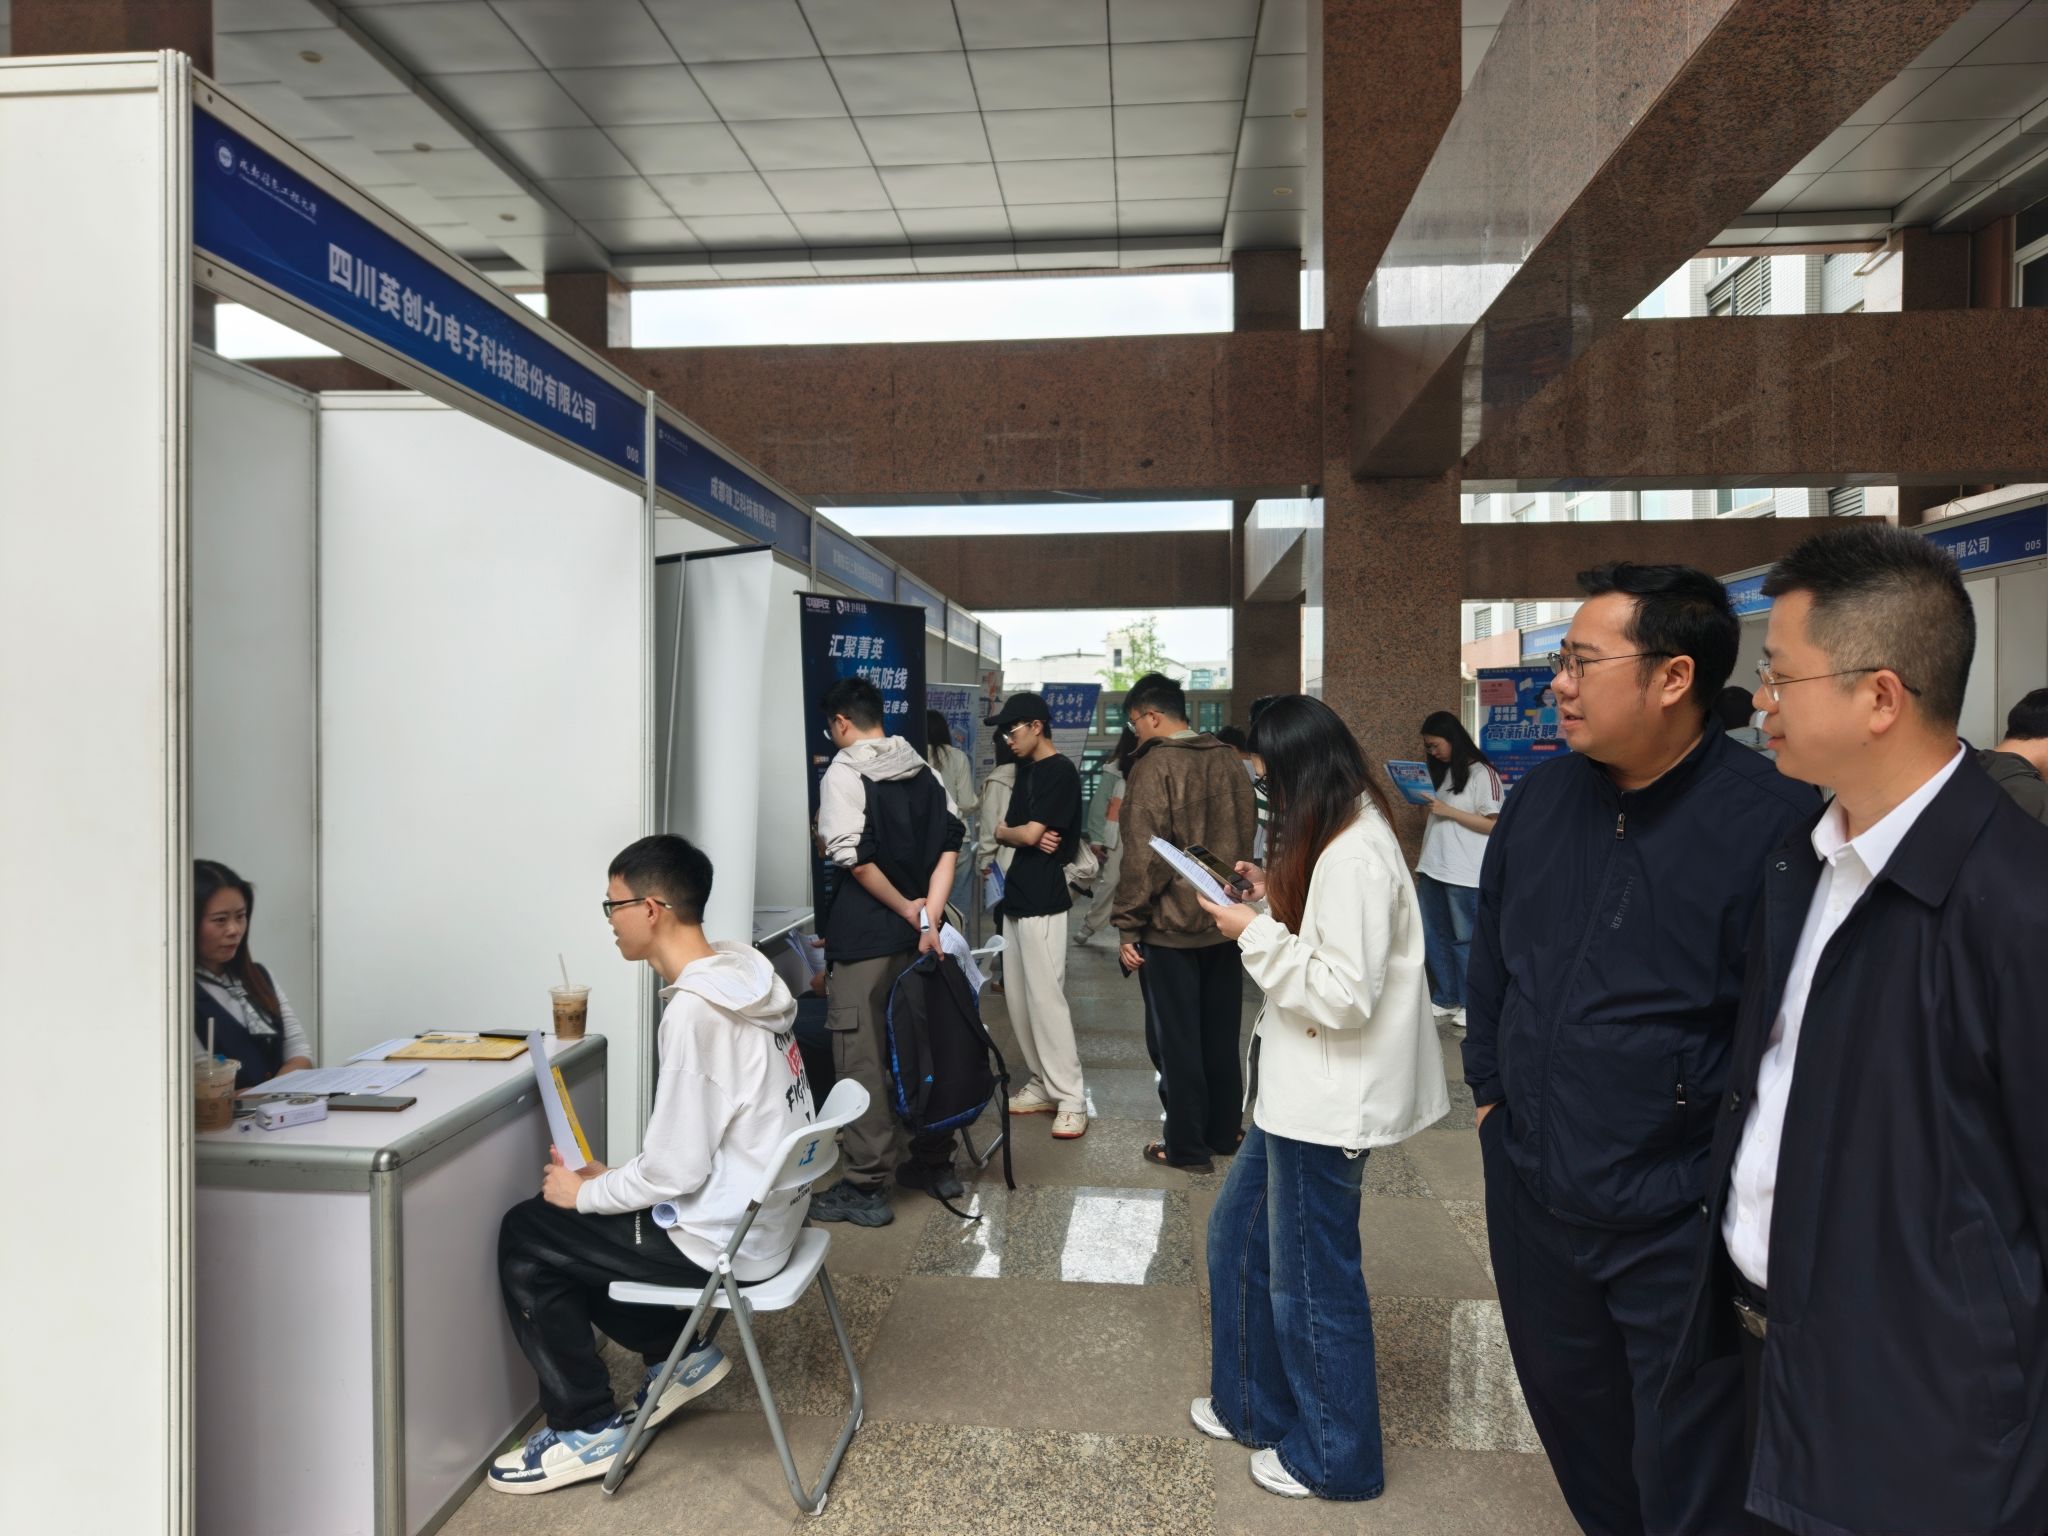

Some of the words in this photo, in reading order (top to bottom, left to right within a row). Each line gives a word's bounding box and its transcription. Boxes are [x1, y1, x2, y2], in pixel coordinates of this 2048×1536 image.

[328, 243, 597, 430] 四川英创力电子科技股份有限公司
[626, 445, 639, 464] 008
[1943, 536, 1990, 559] 有限公司
[2025, 539, 2041, 551] 005
[828, 634, 885, 660] 汇聚菁英
